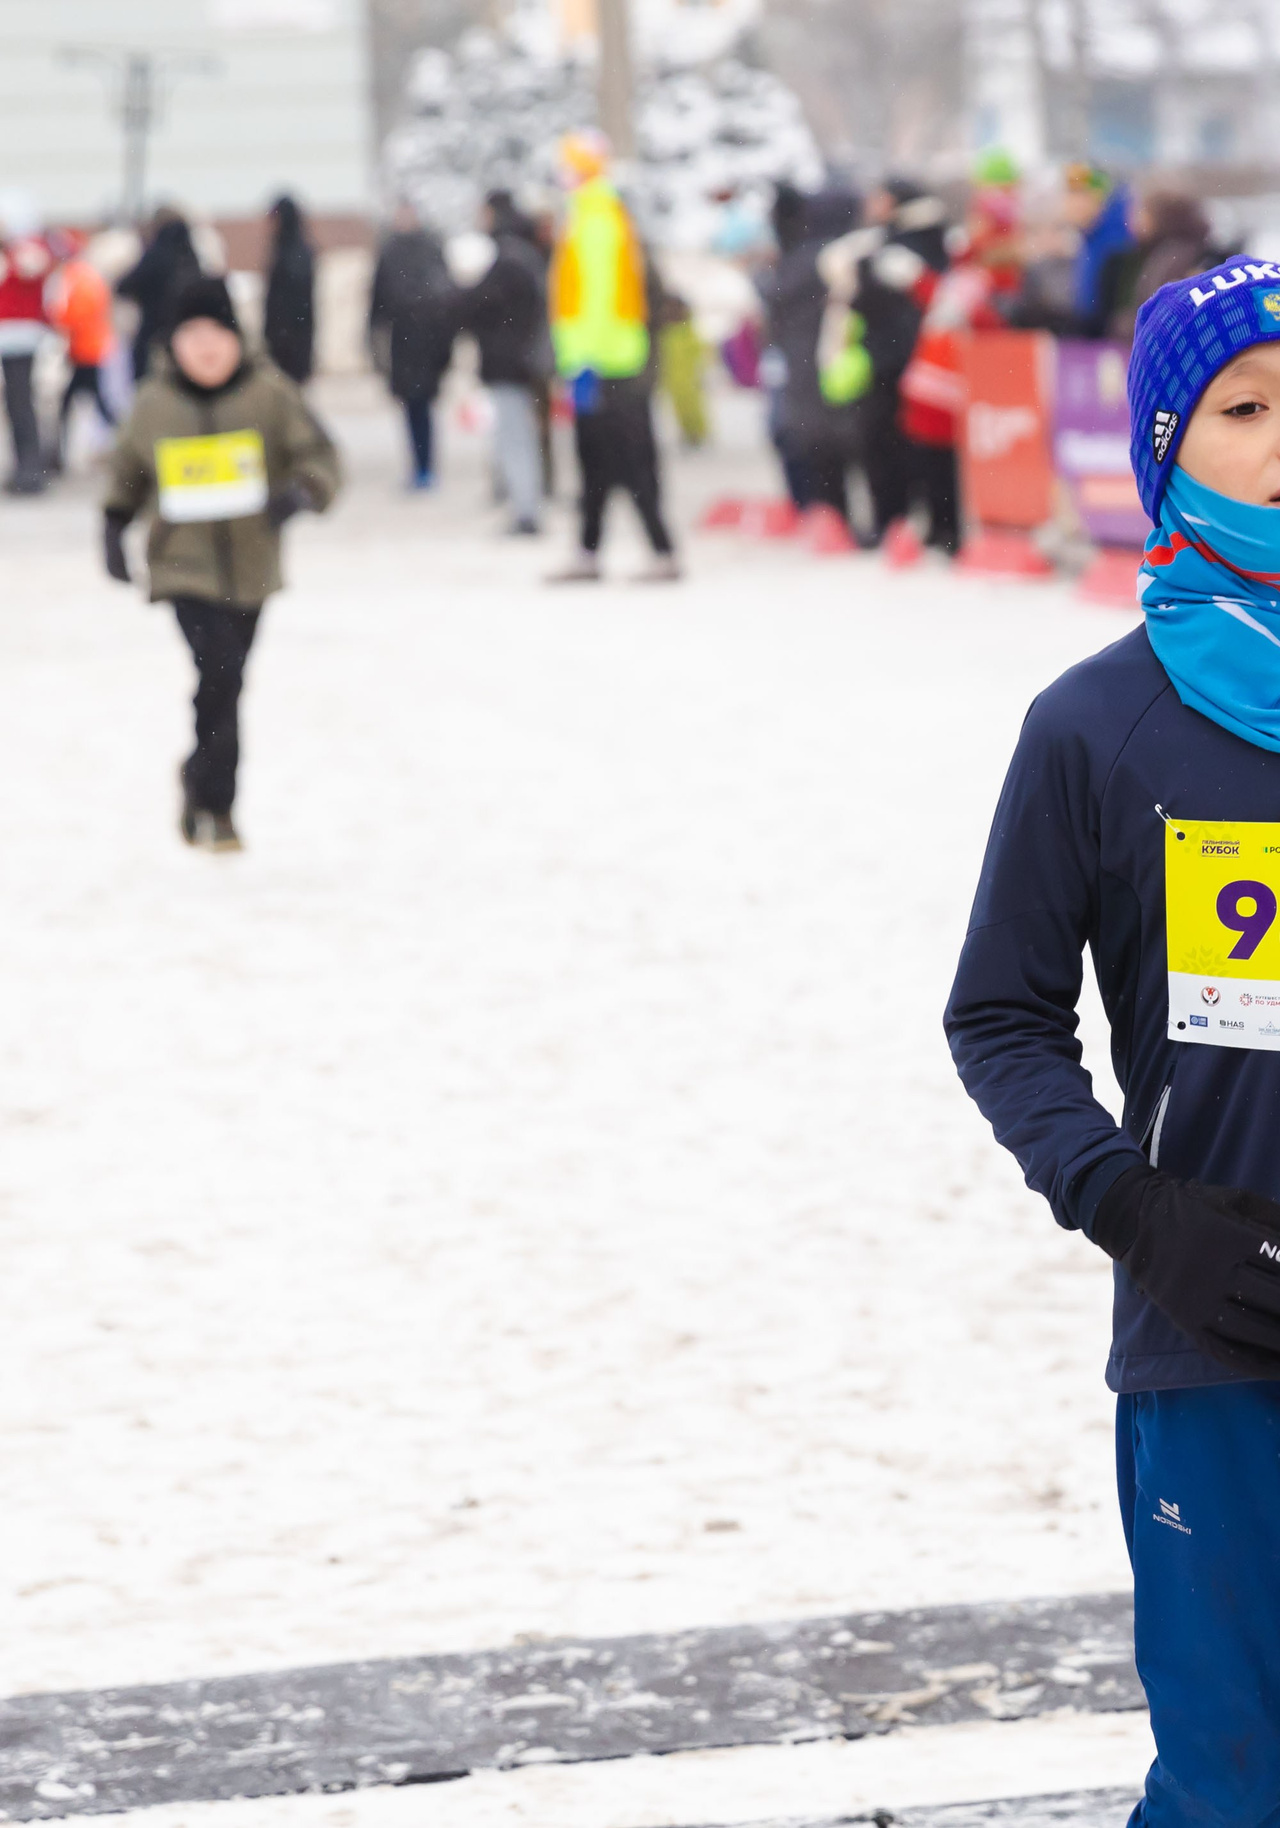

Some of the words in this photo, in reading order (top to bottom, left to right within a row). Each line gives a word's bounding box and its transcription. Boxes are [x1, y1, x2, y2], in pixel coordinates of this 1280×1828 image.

[1157, 413, 1177, 461] adidas
[1202, 846, 1239, 854] КУБОК
[1226, 1021, 1245, 1029] HAS
[1152, 1513, 1192, 1535] NORDSKI
